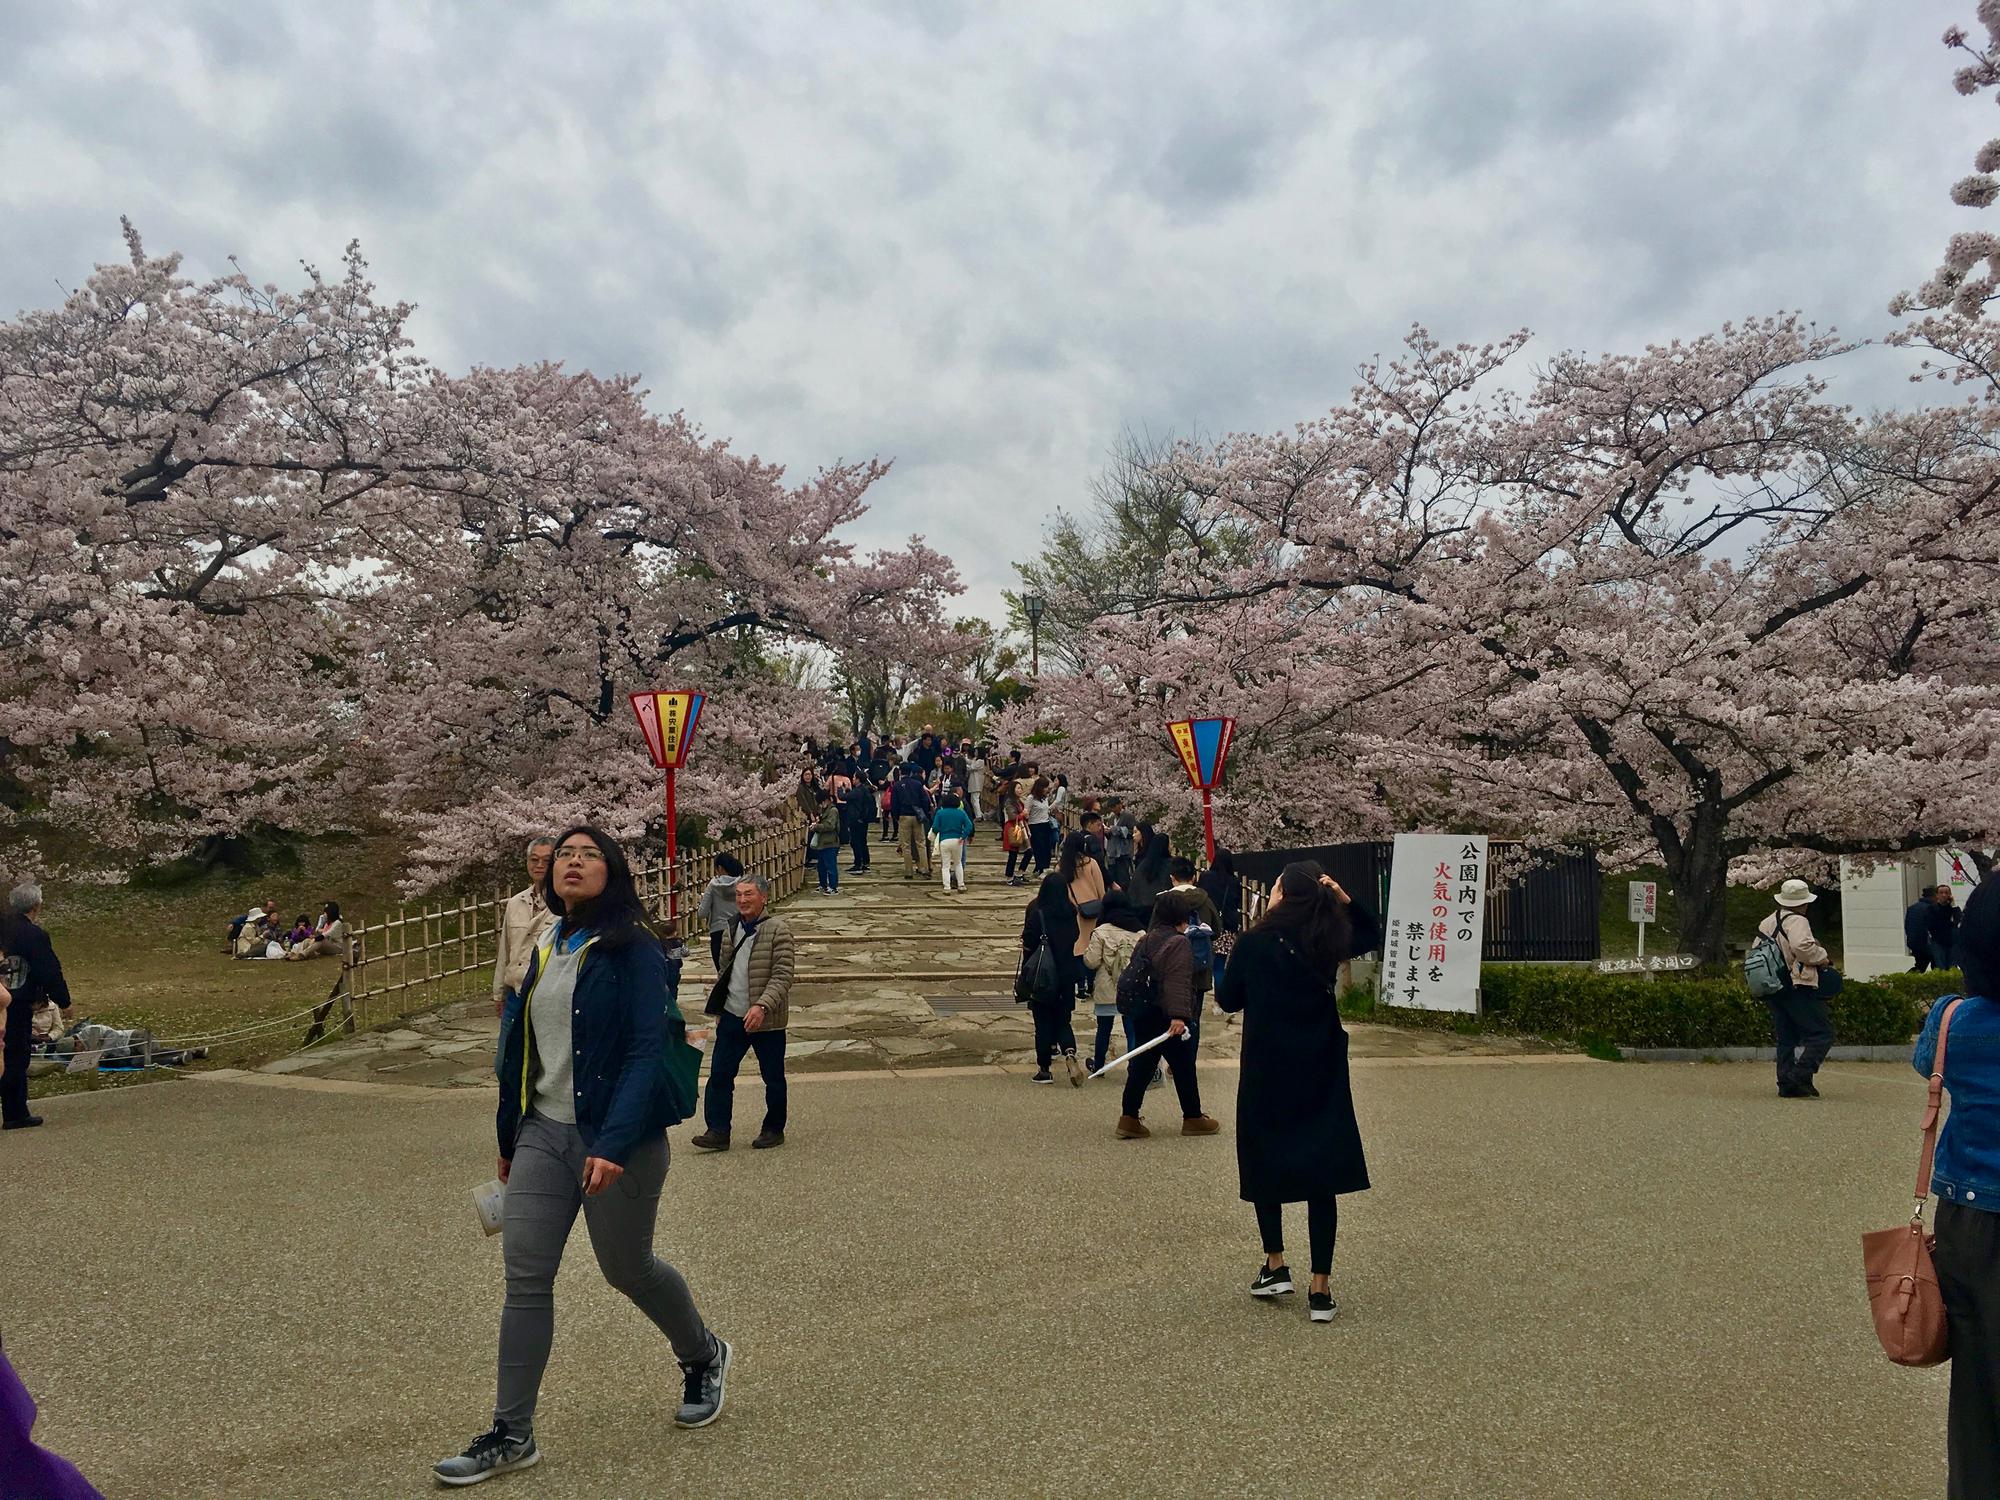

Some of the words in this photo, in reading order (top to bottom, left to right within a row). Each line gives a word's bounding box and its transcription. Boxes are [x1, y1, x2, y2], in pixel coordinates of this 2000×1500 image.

[1427, 861, 1453, 982] 火気の使用を
[1457, 841, 1481, 942] 公園内での
[1386, 919, 1400, 1001] 姫路城管理事務所
[1402, 921, 1425, 1002] 禁じます
